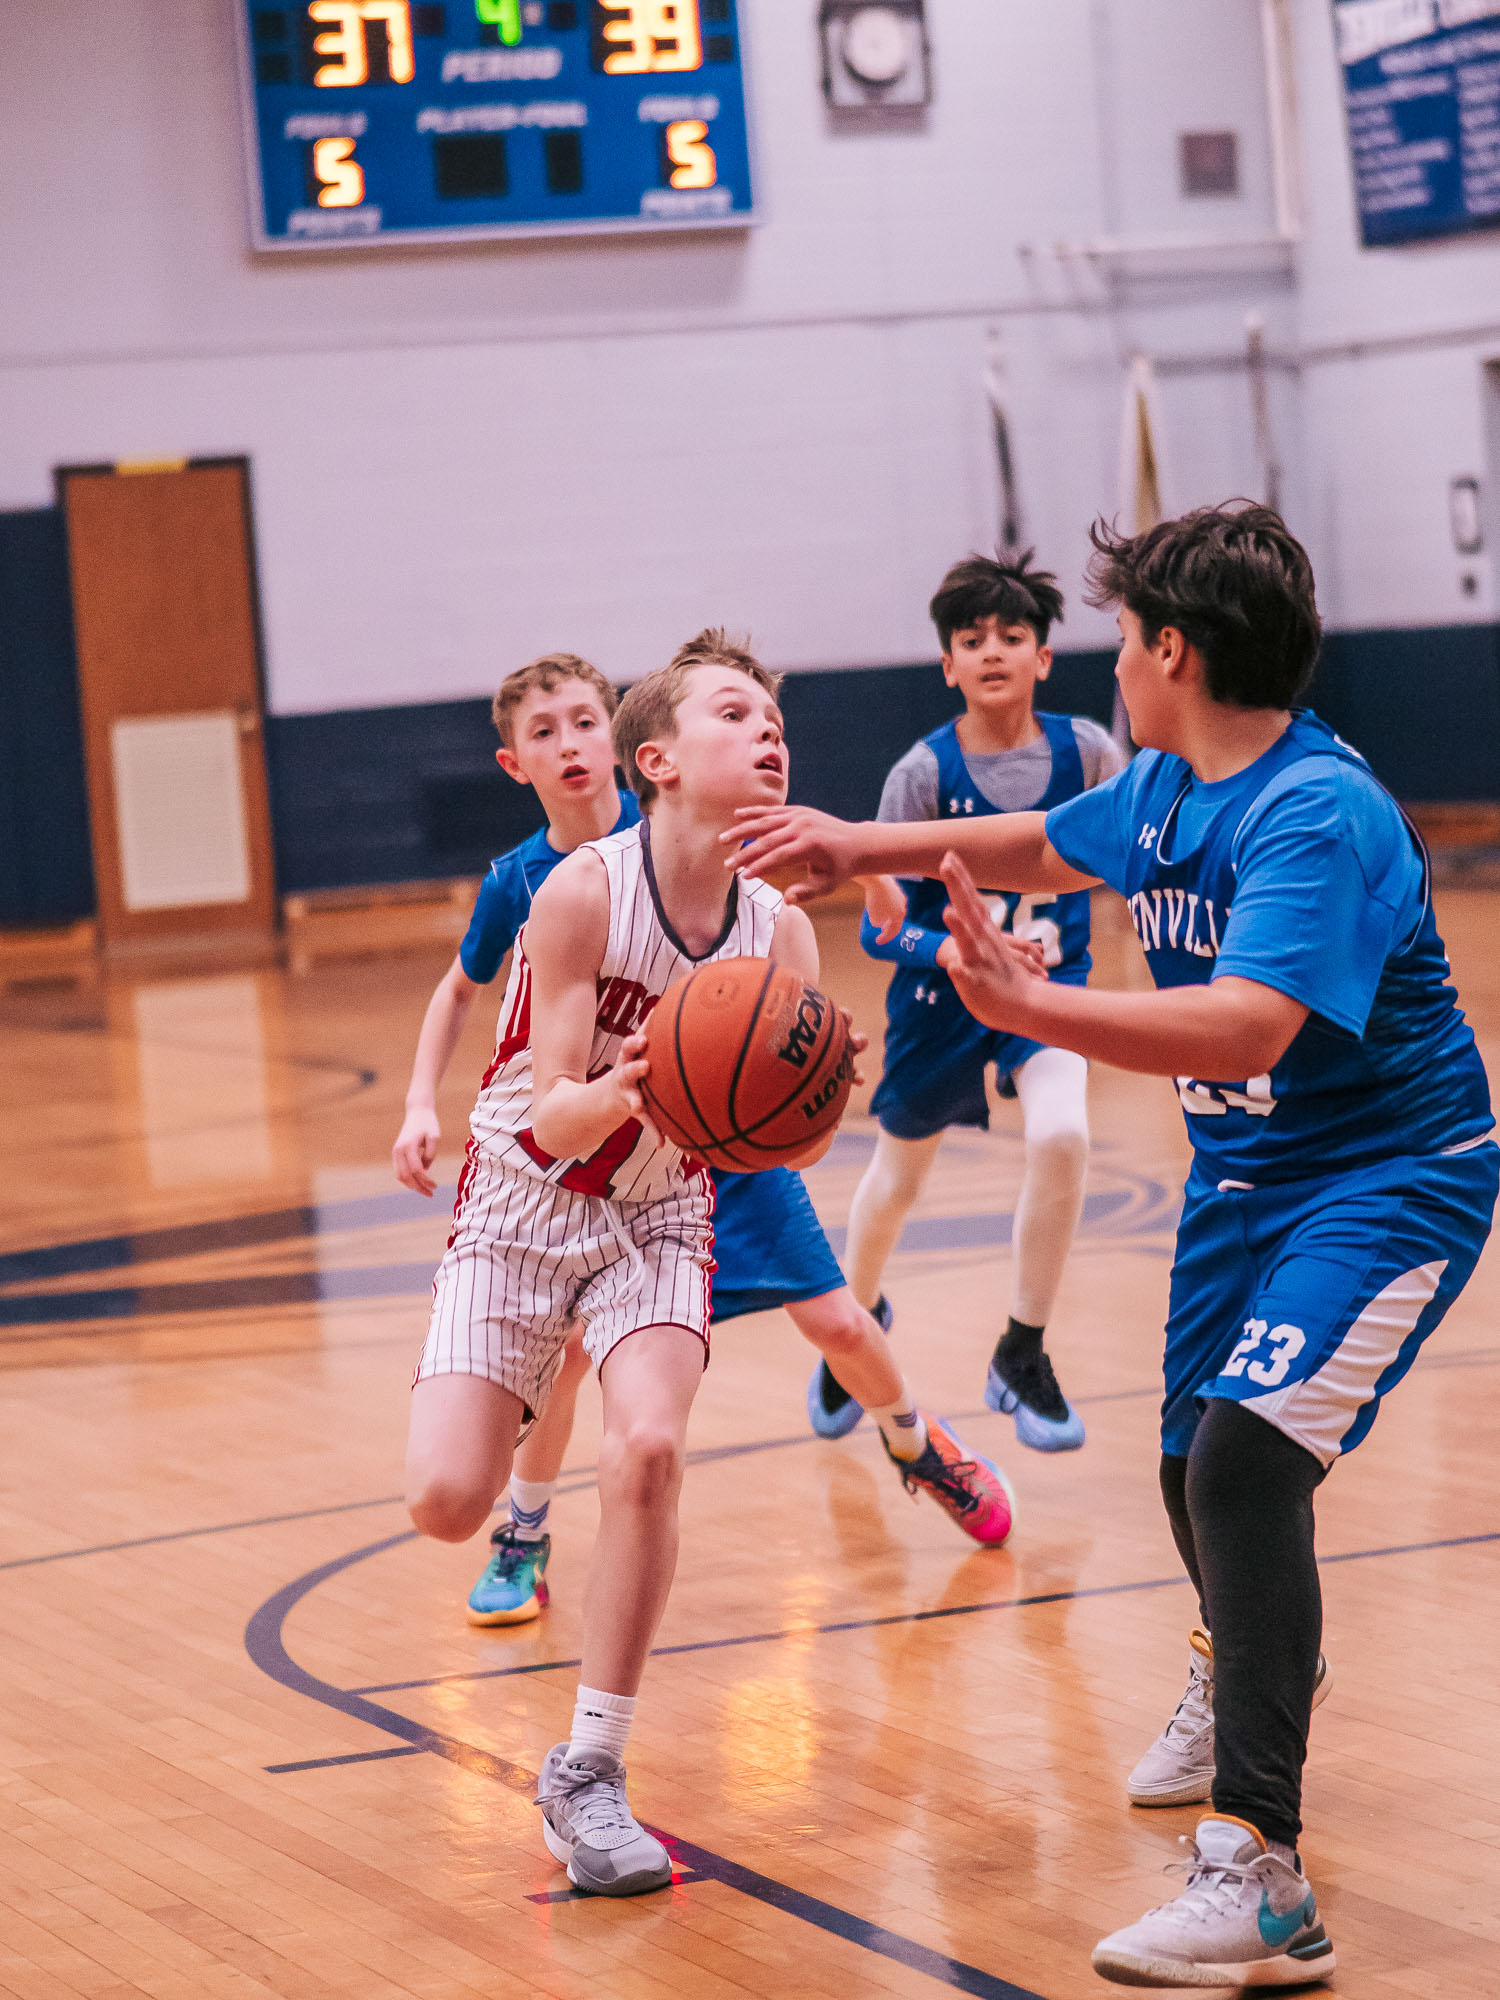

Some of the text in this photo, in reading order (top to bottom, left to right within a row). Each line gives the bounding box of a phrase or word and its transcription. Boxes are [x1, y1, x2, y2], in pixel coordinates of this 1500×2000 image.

[308, 0, 415, 87] 37
[598, 0, 703, 75] 39
[313, 137, 366, 208] 5
[665, 119, 718, 190] 5
[778, 983, 827, 1069] NCAA
[1219, 1317, 1306, 1387] 23
